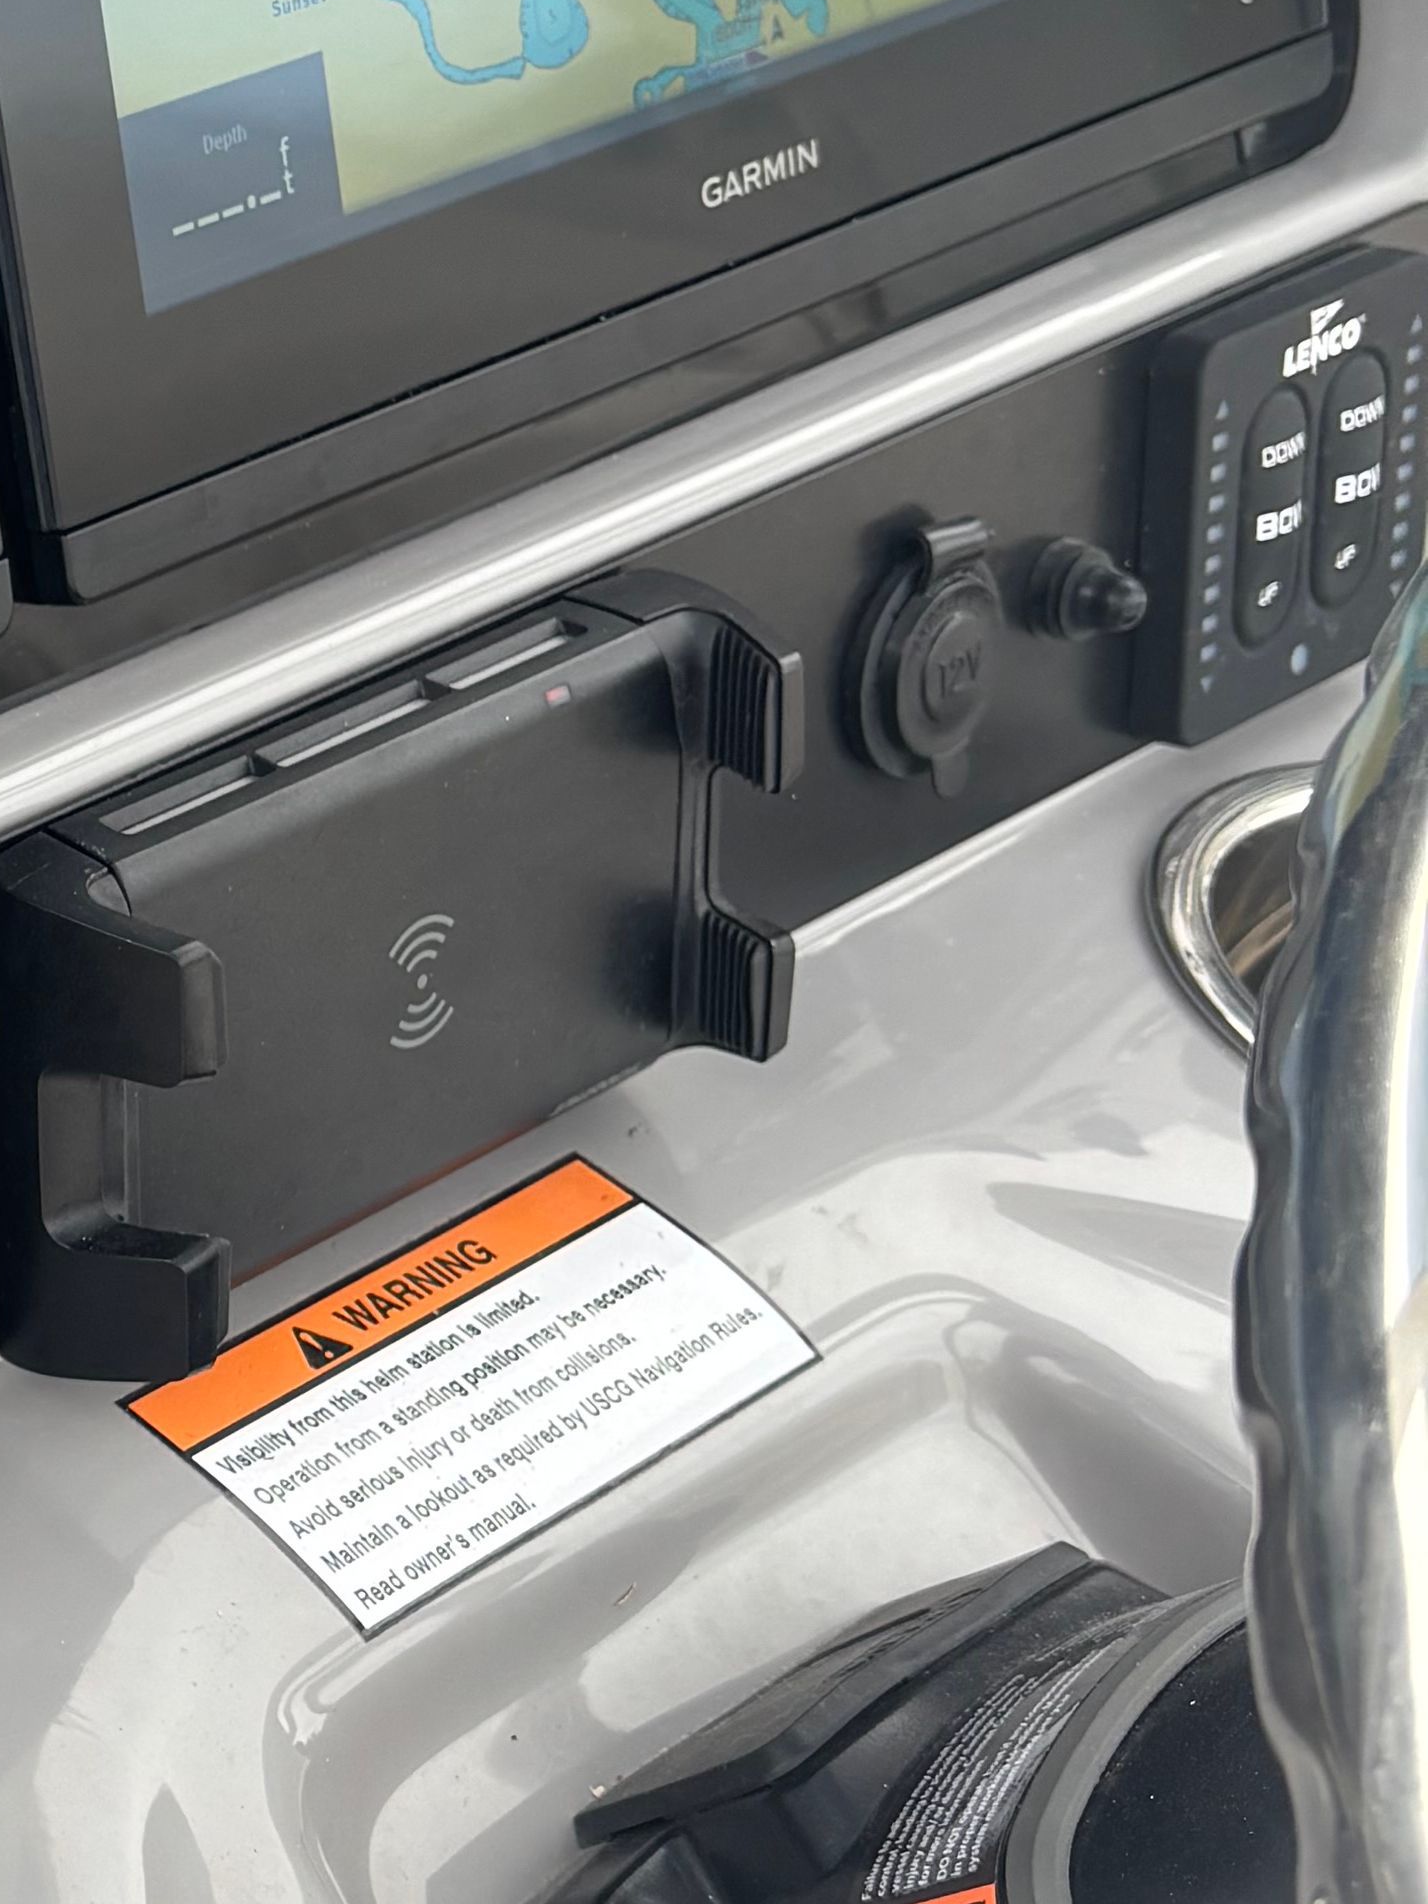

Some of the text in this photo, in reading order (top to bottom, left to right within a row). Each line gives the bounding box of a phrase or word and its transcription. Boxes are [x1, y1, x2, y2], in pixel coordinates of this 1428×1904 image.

[202, 122, 248, 155] Depth
[701, 139, 820, 209] GARMIN
[1283, 317, 1363, 378] LENCO
[332, 1239, 498, 1331] WARNING
[215, 1289, 540, 1475] Visibility from this helm station is limited.
[253, 1264, 667, 1506] Operation from a standing position may be necessary.
[288, 1331, 637, 1540] Avoid serious injury or death from collisions.
[319, 1304, 764, 1574] Maintain a lookout as required by USCG Navigation Rules.
[353, 1492, 537, 1610] Read owner's manual.
